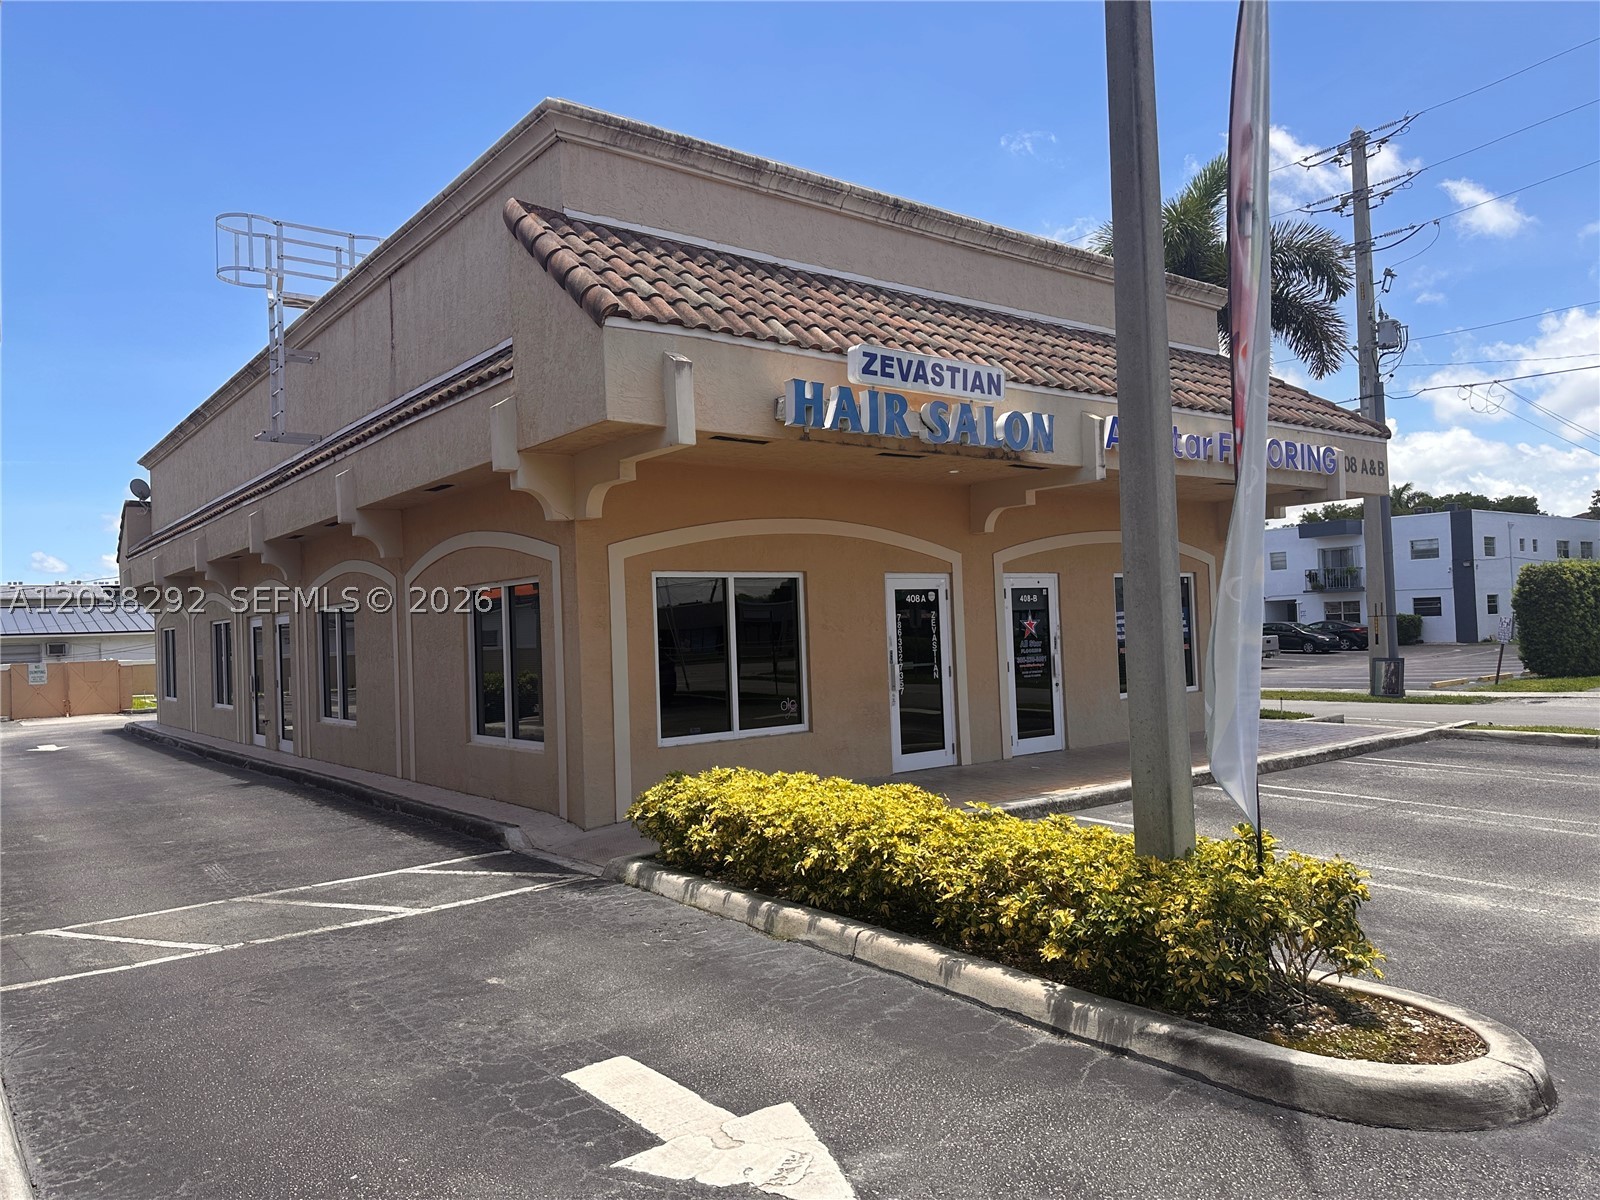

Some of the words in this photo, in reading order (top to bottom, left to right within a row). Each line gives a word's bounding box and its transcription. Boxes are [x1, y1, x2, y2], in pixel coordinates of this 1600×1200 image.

[861, 351, 1002, 396] ZEVASTIAN
[784, 378, 912, 437] HAIR
[920, 400, 1055, 453] SALON
[1172, 425, 1213, 460] tar
[1214, 432, 1336, 475] FORING
[1344, 455, 1358, 473] 08
[930, 610, 939, 679] ZEVASTIAN
